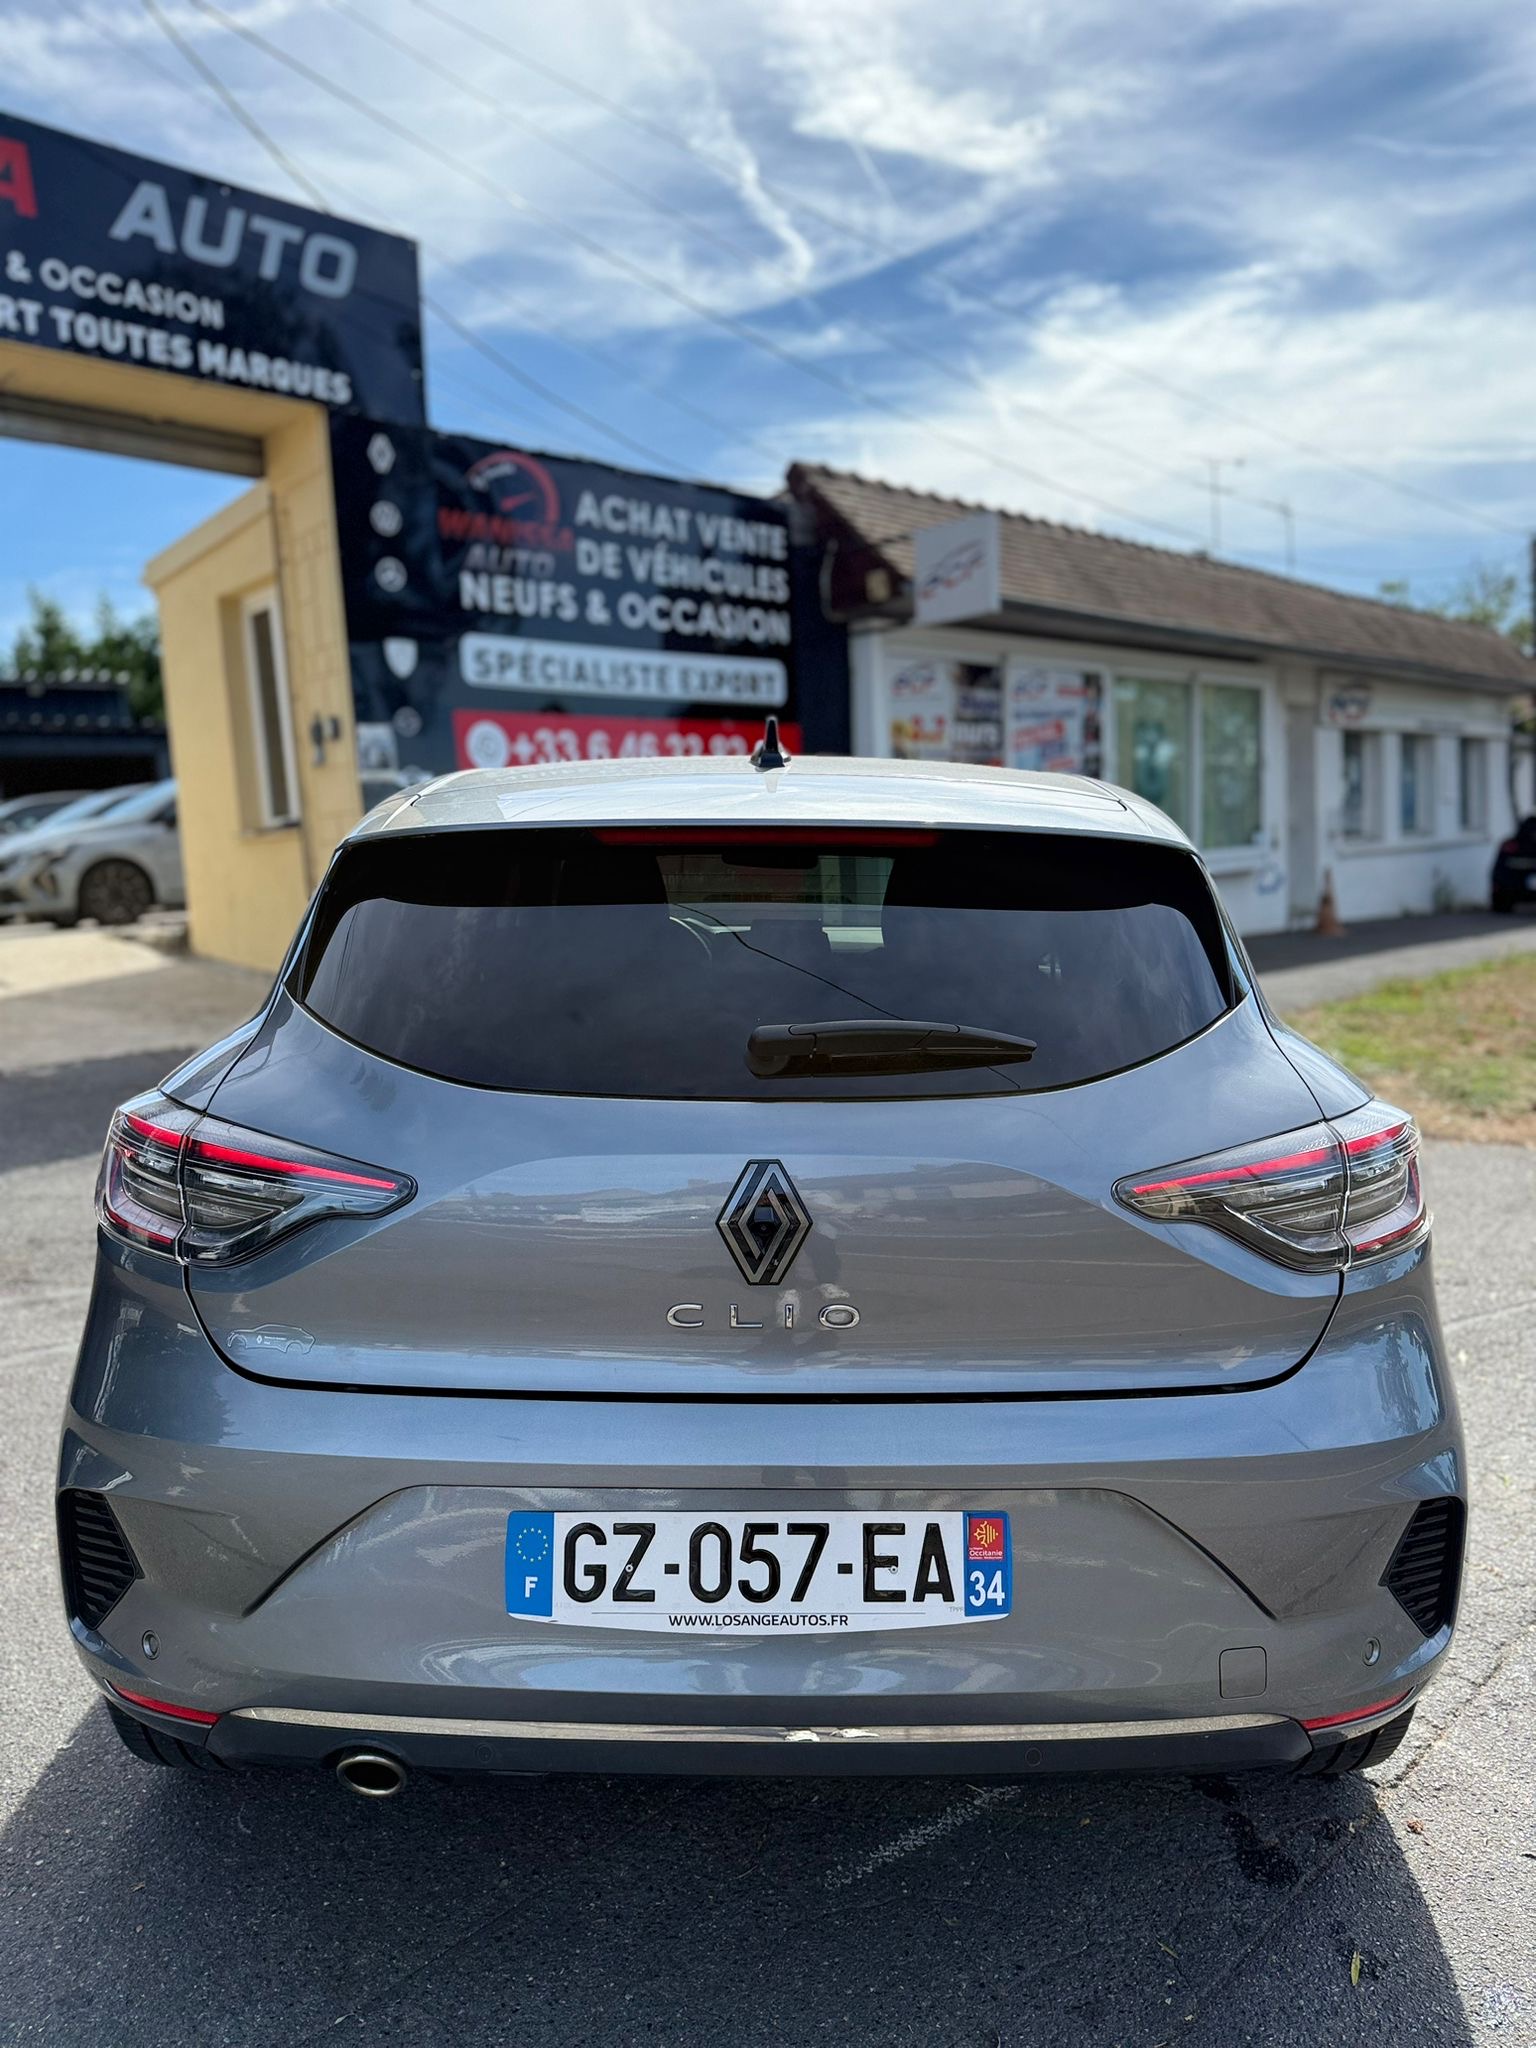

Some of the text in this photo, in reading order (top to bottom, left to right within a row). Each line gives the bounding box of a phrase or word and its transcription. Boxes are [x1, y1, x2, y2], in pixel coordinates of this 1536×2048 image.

[108, 180, 358, 300] AUTO
[5, 250, 225, 331] & OCCASION
[48, 305, 194, 369] TOUTES
[198, 339, 353, 404] MARQUES
[575, 490, 788, 561] ACHAT VENTE
[463, 543, 556, 578] AUTO
[576, 536, 790, 604] DE VÉHICULES
[458, 570, 792, 646] NEUFS & OCCASION
[472, 642, 776, 696] SPÉCIALISTE EXPORT
[666, 1303, 860, 1329] CLIO
[563, 1522, 956, 1603] GZ-057-EA
[969, 1548, 1003, 1557] Occitanie
[524, 1575, 537, 1598] F
[969, 1570, 1006, 1607] 34
[668, 1614, 849, 1627] WWW.LOSANGEAUTOS.FR
